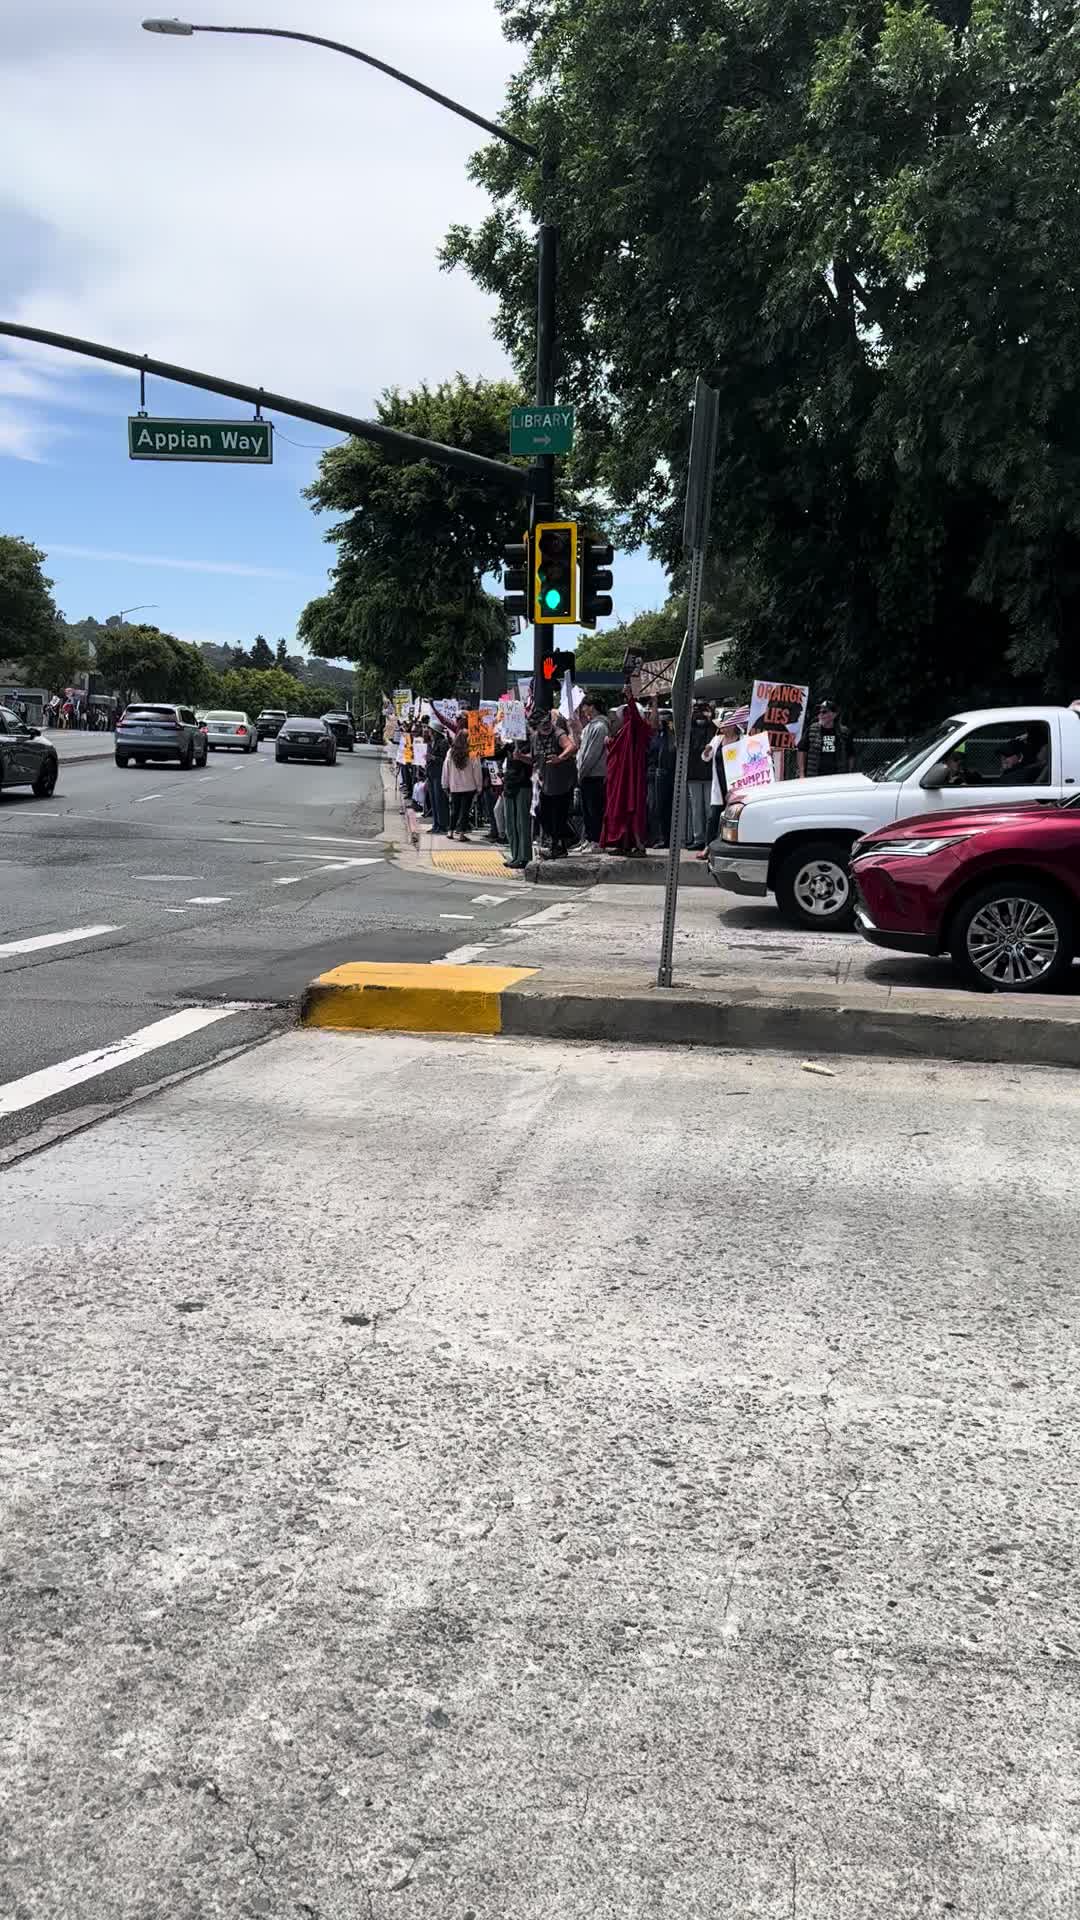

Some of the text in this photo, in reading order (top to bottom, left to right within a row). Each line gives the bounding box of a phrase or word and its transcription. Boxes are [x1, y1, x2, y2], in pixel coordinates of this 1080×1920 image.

[512, 412, 571, 429] LIBRARY
[137, 428, 264, 455] Appian Way
[756, 683, 805, 704] ORANGE
[763, 706, 791, 724] LIES
[749, 728, 798, 750] TTER
[729, 769, 772, 790] TRUMPTY
